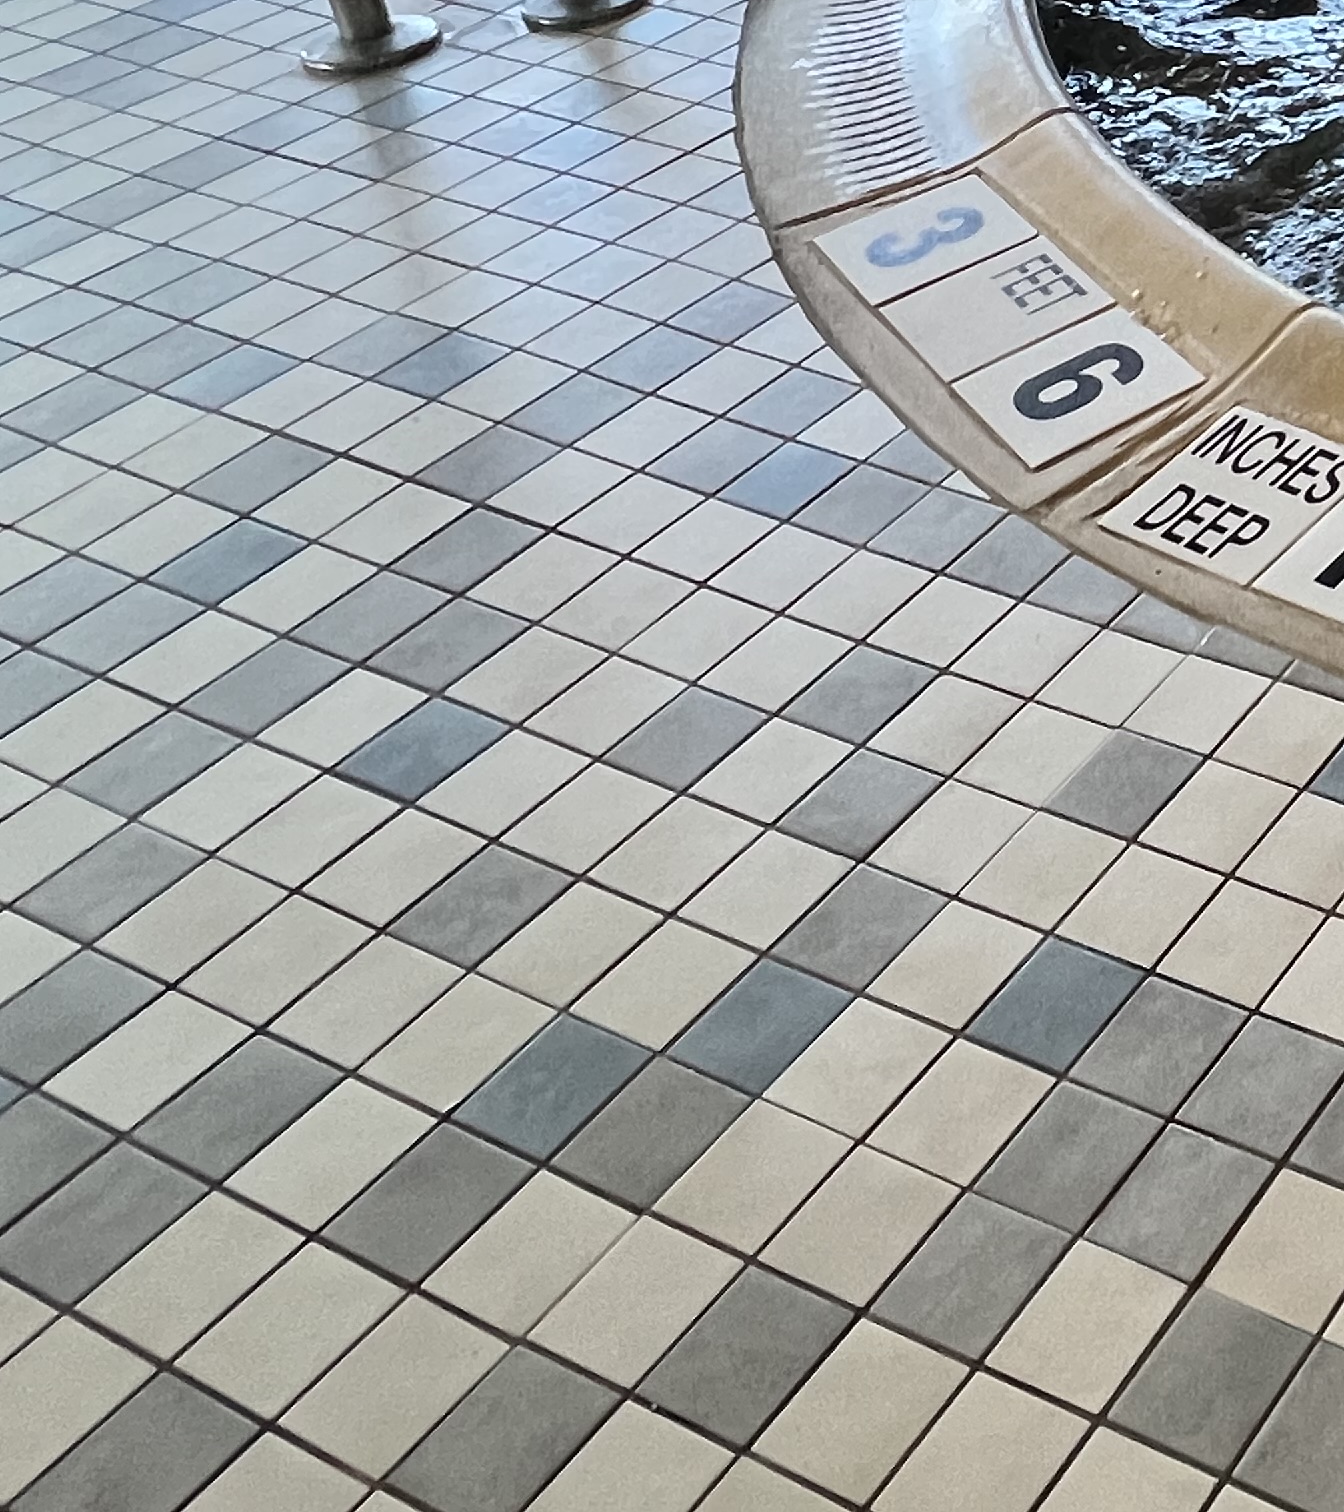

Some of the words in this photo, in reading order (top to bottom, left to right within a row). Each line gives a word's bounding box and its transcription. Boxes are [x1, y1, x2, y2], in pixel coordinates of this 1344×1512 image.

[863, 207, 984, 269] 3
[990, 250, 1089, 317] FEET
[1012, 342, 1145, 421] 6
[1133, 482, 1271, 559] DEEP
